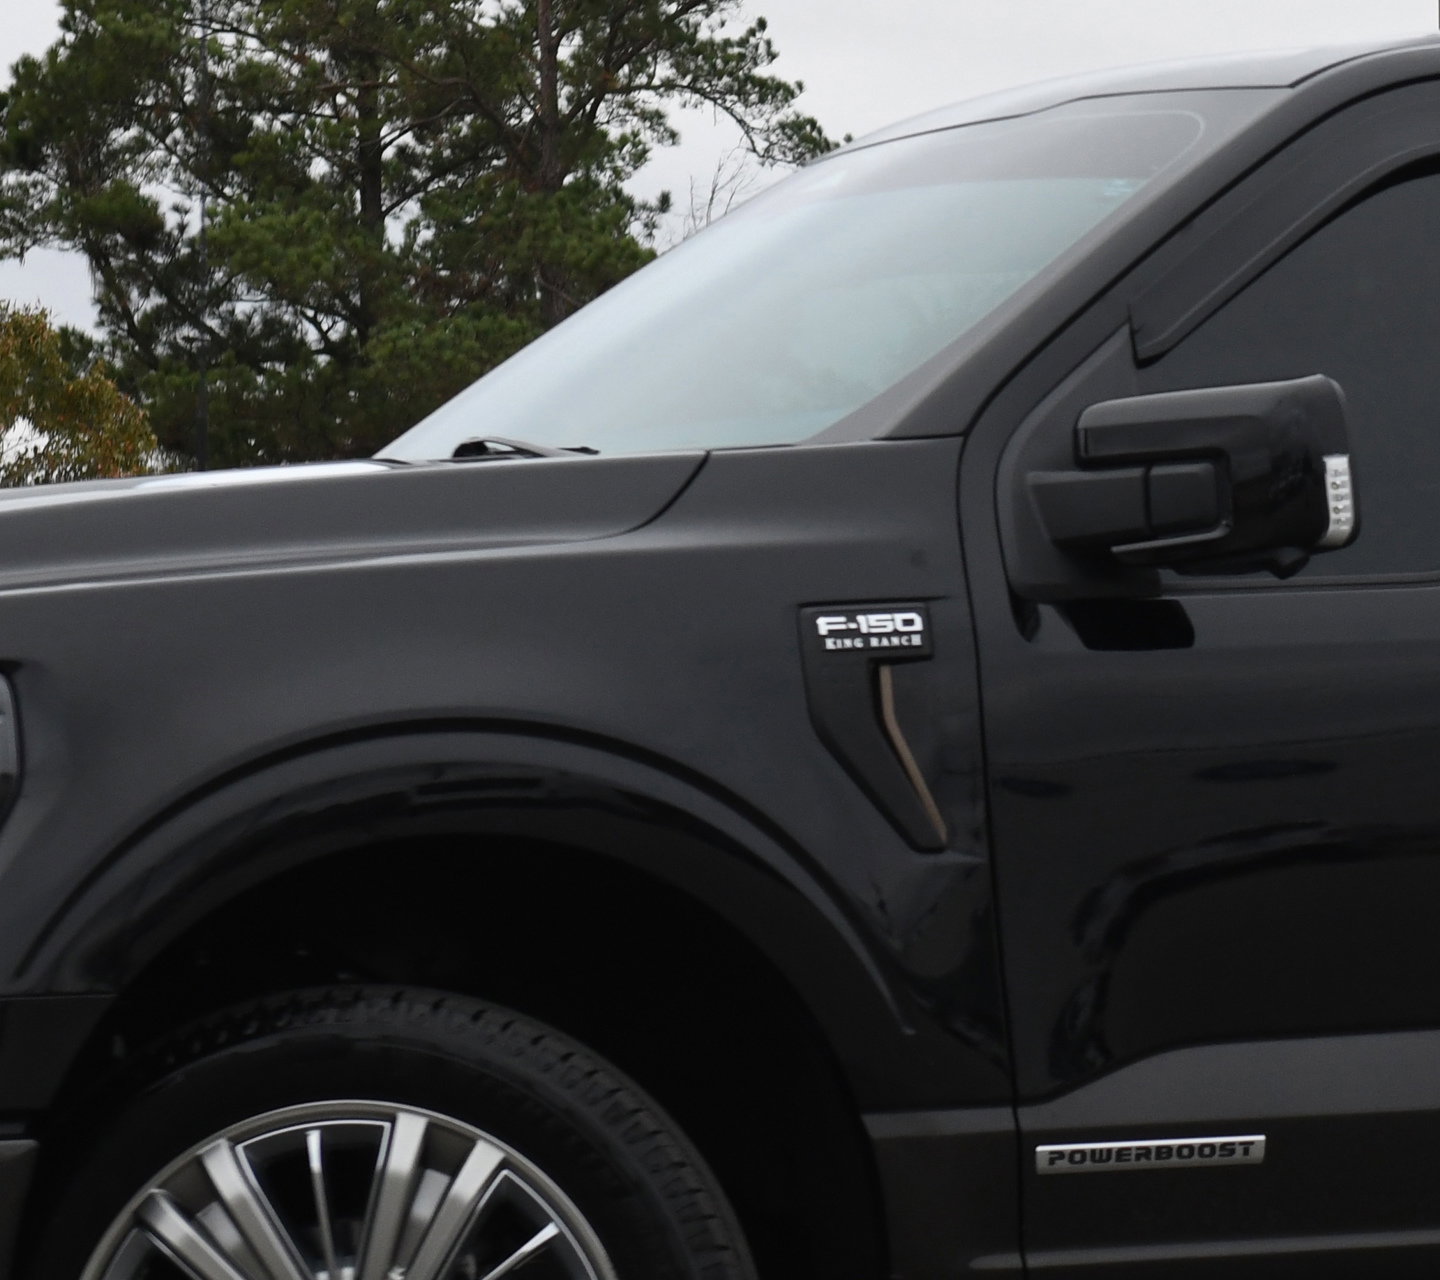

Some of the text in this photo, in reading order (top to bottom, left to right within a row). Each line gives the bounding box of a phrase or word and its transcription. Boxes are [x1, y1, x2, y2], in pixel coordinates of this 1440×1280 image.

[816, 612, 923, 635] F-150
[825, 634, 922, 649] KING RANCH
[1048, 1141, 1255, 1166] POWERBOOST
